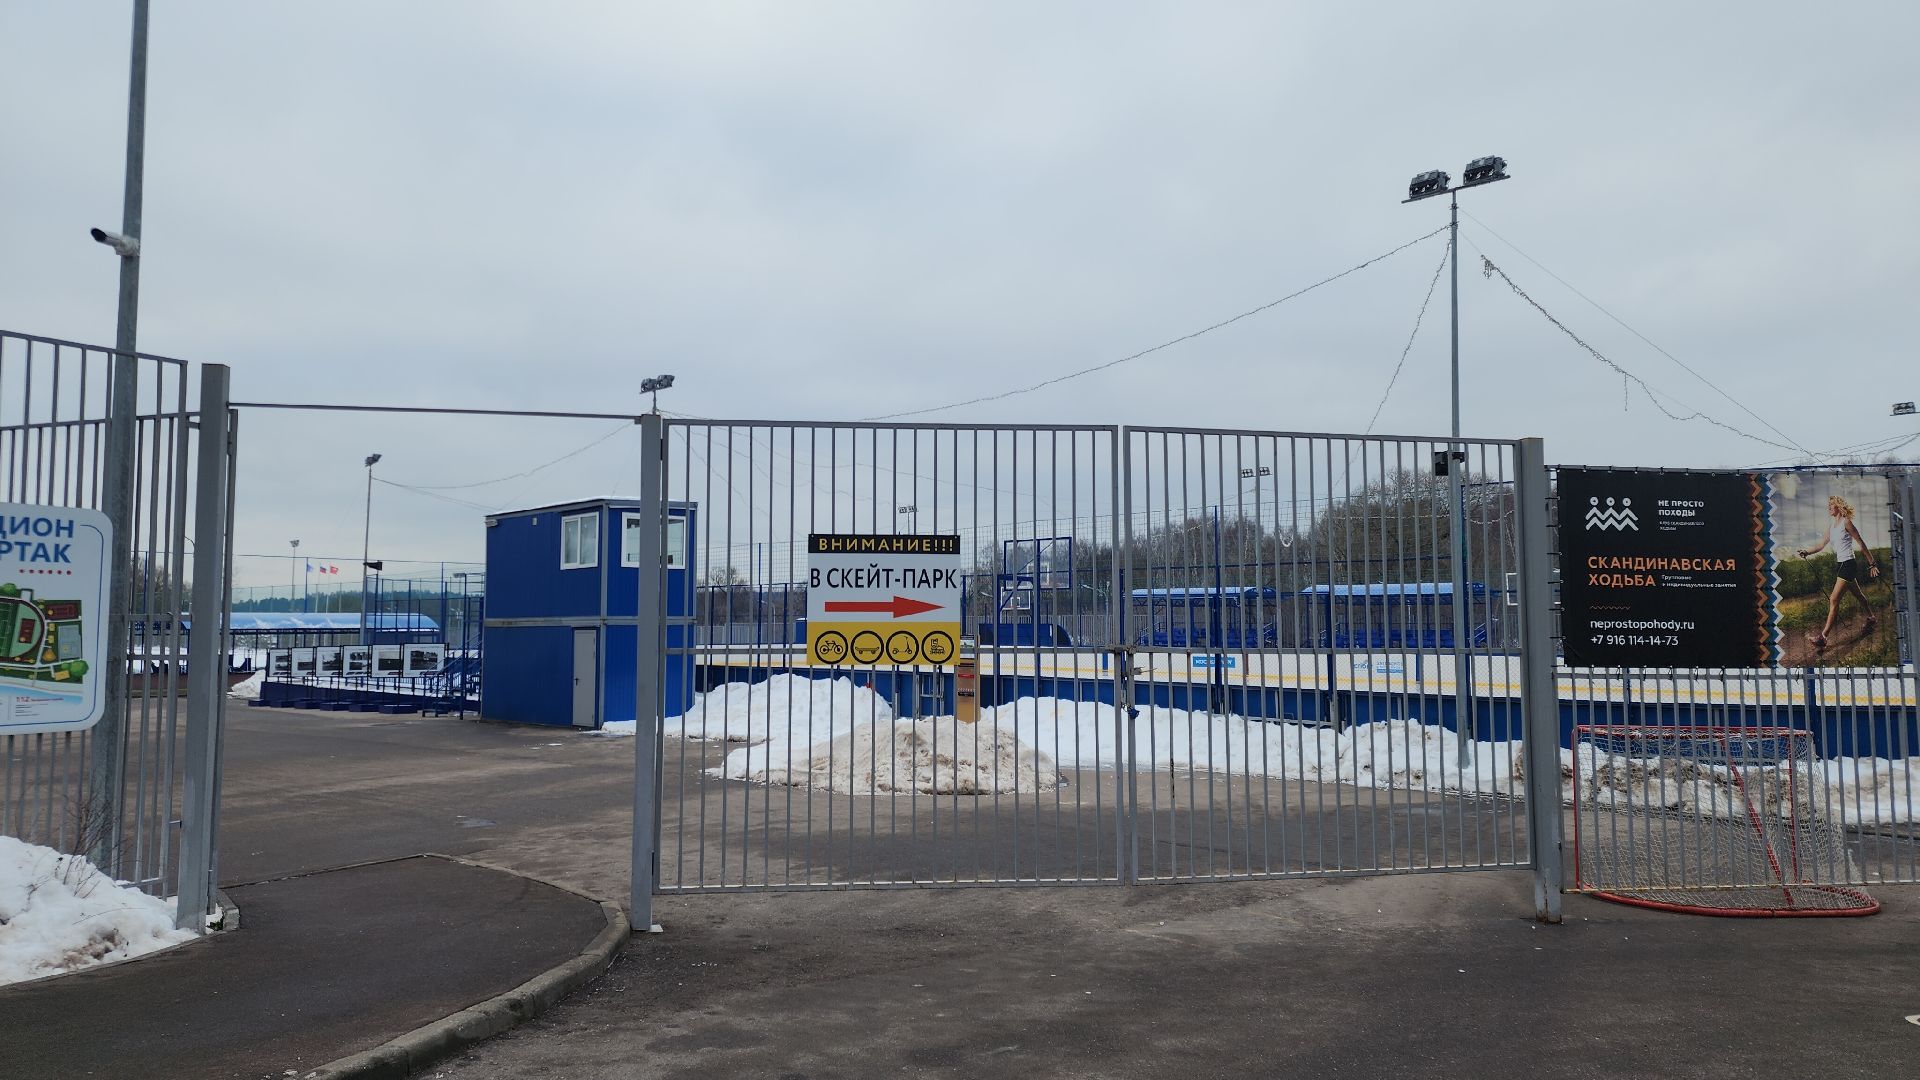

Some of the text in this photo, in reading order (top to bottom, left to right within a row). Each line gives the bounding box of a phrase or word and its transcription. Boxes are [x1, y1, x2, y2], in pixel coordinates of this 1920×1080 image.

[1658, 499, 1705, 508] НЕ ПРОСТО
[1658, 509, 1696, 517] ПОХОДЫ
[818, 538, 953, 552] ВНИМАНИЕ!!!
[1588, 556, 1736, 572] СКАНДИНАВСКАЯ
[810, 563, 958, 588] В СКЕЙТ-ПАРК
[1588, 573, 1656, 588] ХОДЬБА
[1590, 619, 1695, 631] neprostopohody.ru
[1590, 634, 1679, 646] +7 916 114-14-73
